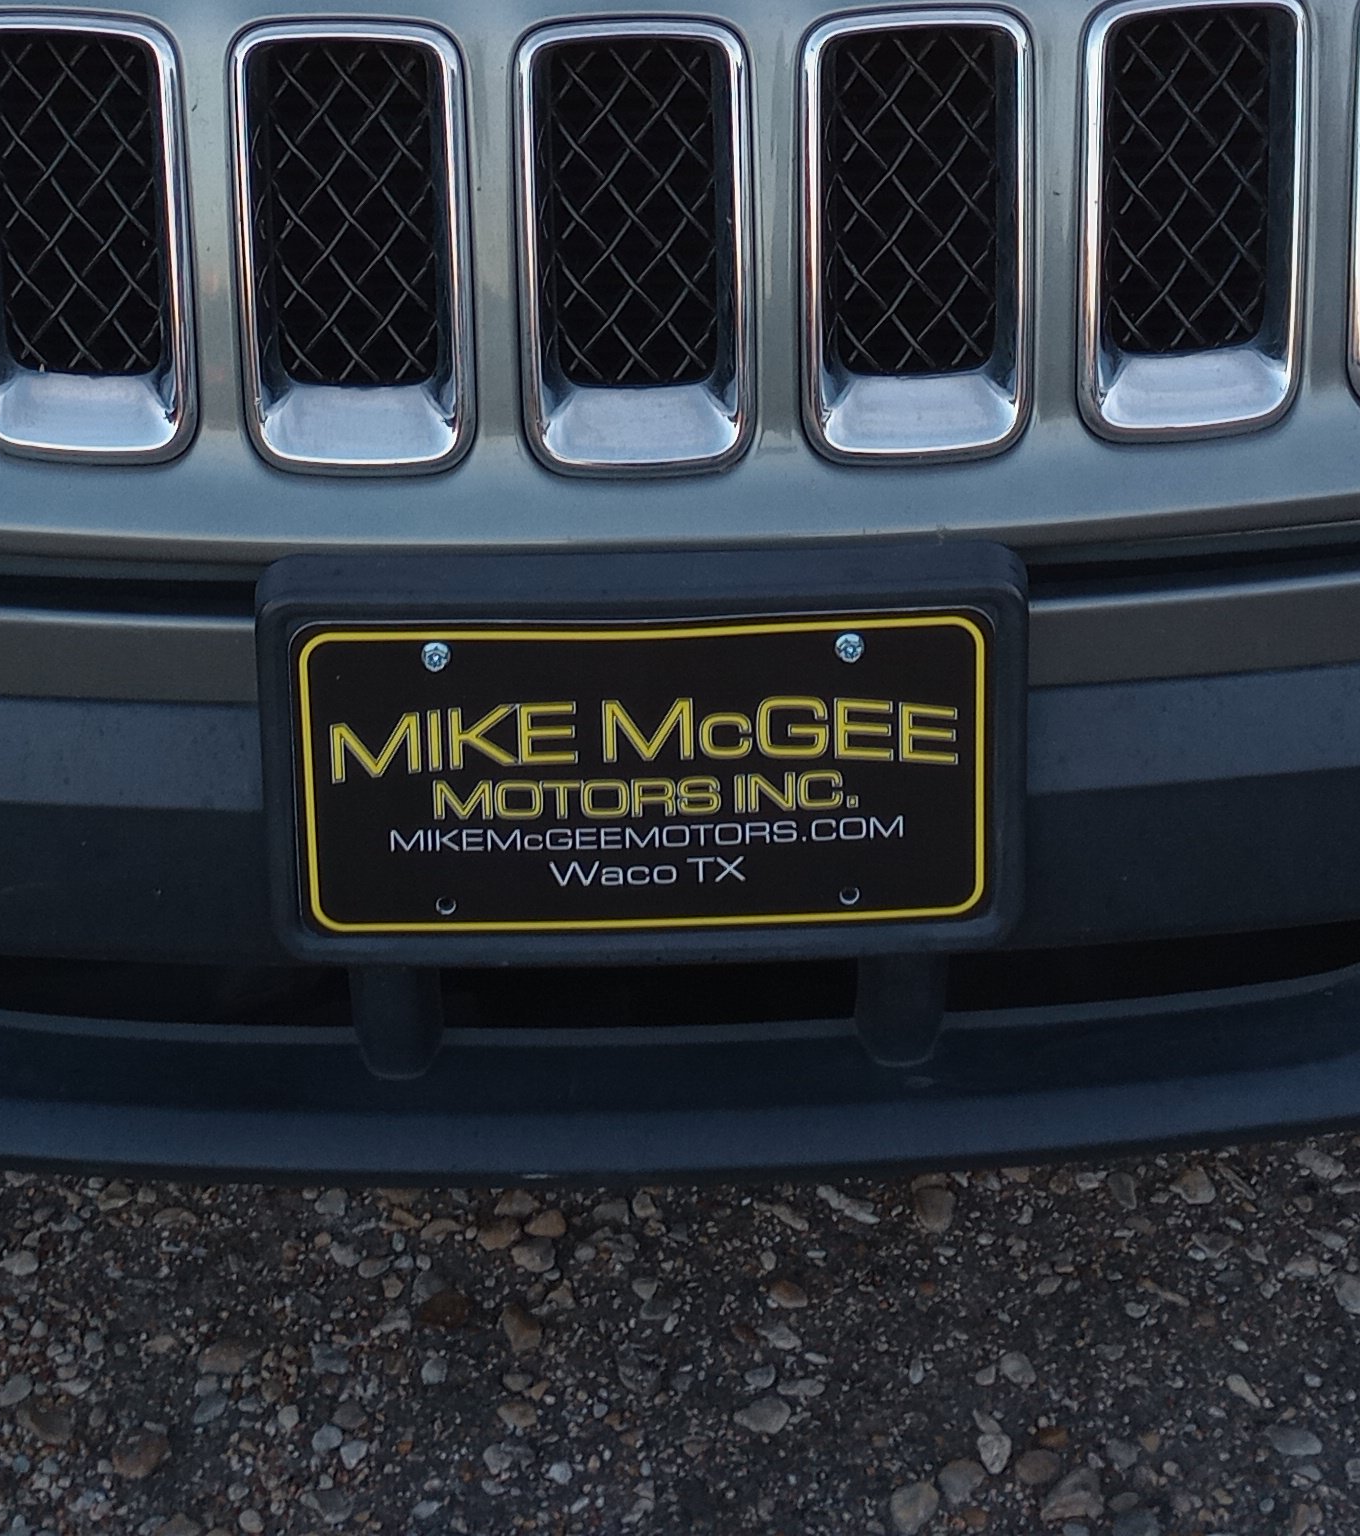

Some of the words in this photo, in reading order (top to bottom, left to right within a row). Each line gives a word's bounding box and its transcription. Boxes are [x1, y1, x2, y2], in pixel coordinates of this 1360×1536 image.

[329, 701, 578, 784] MIKE
[601, 695, 959, 764] McGEE
[433, 775, 722, 821] MOTORS
[734, 769, 859, 815] INC.
[389, 814, 904, 853] MIKEMcGEEMOTORS.COM
[548, 861, 678, 888] Waco
[686, 855, 746, 884] TX
